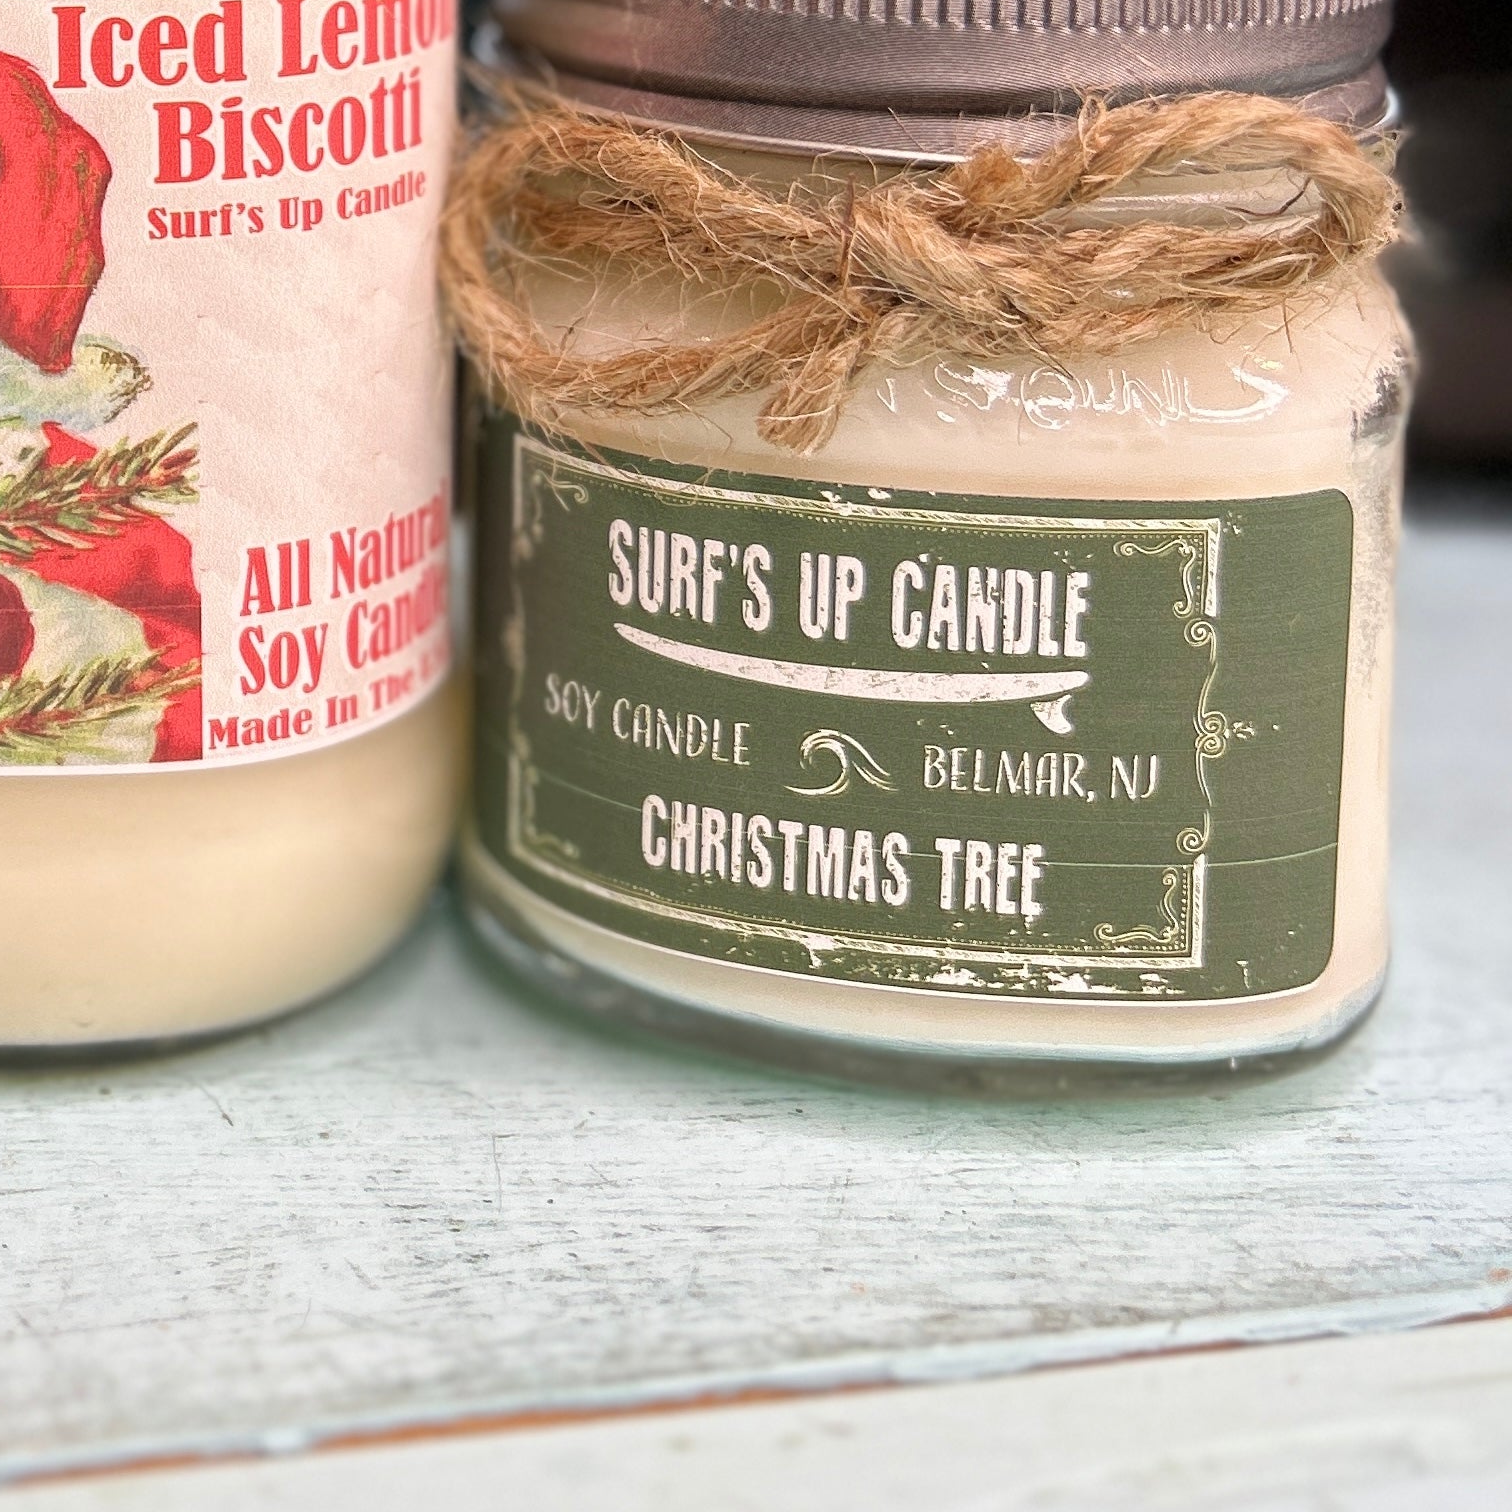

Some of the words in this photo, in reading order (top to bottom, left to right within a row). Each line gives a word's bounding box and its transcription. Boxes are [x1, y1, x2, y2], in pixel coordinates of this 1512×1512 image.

[52, 0, 247, 89] Iced
[153, 66, 422, 185] Biscotti
[147, 202, 264, 240] Surf's
[278, 196, 323, 232] Up
[337, 170, 426, 220] Candle
[240, 538, 312, 617] All
[607, 519, 772, 631] SURF'S
[800, 552, 864, 641] UP
[891, 560, 1088, 657] CANDLE
[239, 622, 328, 696] Soy
[208, 708, 312, 750] Made
[325, 693, 358, 729] In
[369, 669, 415, 712] The
[545, 672, 600, 730] SOY
[612, 697, 751, 766] CANDLE
[924, 745, 1095, 804] BELMAR,
[1110, 753, 1157, 801] NJ
[641, 794, 910, 907] CHRISTMAS
[935, 837, 1044, 916] TREE
